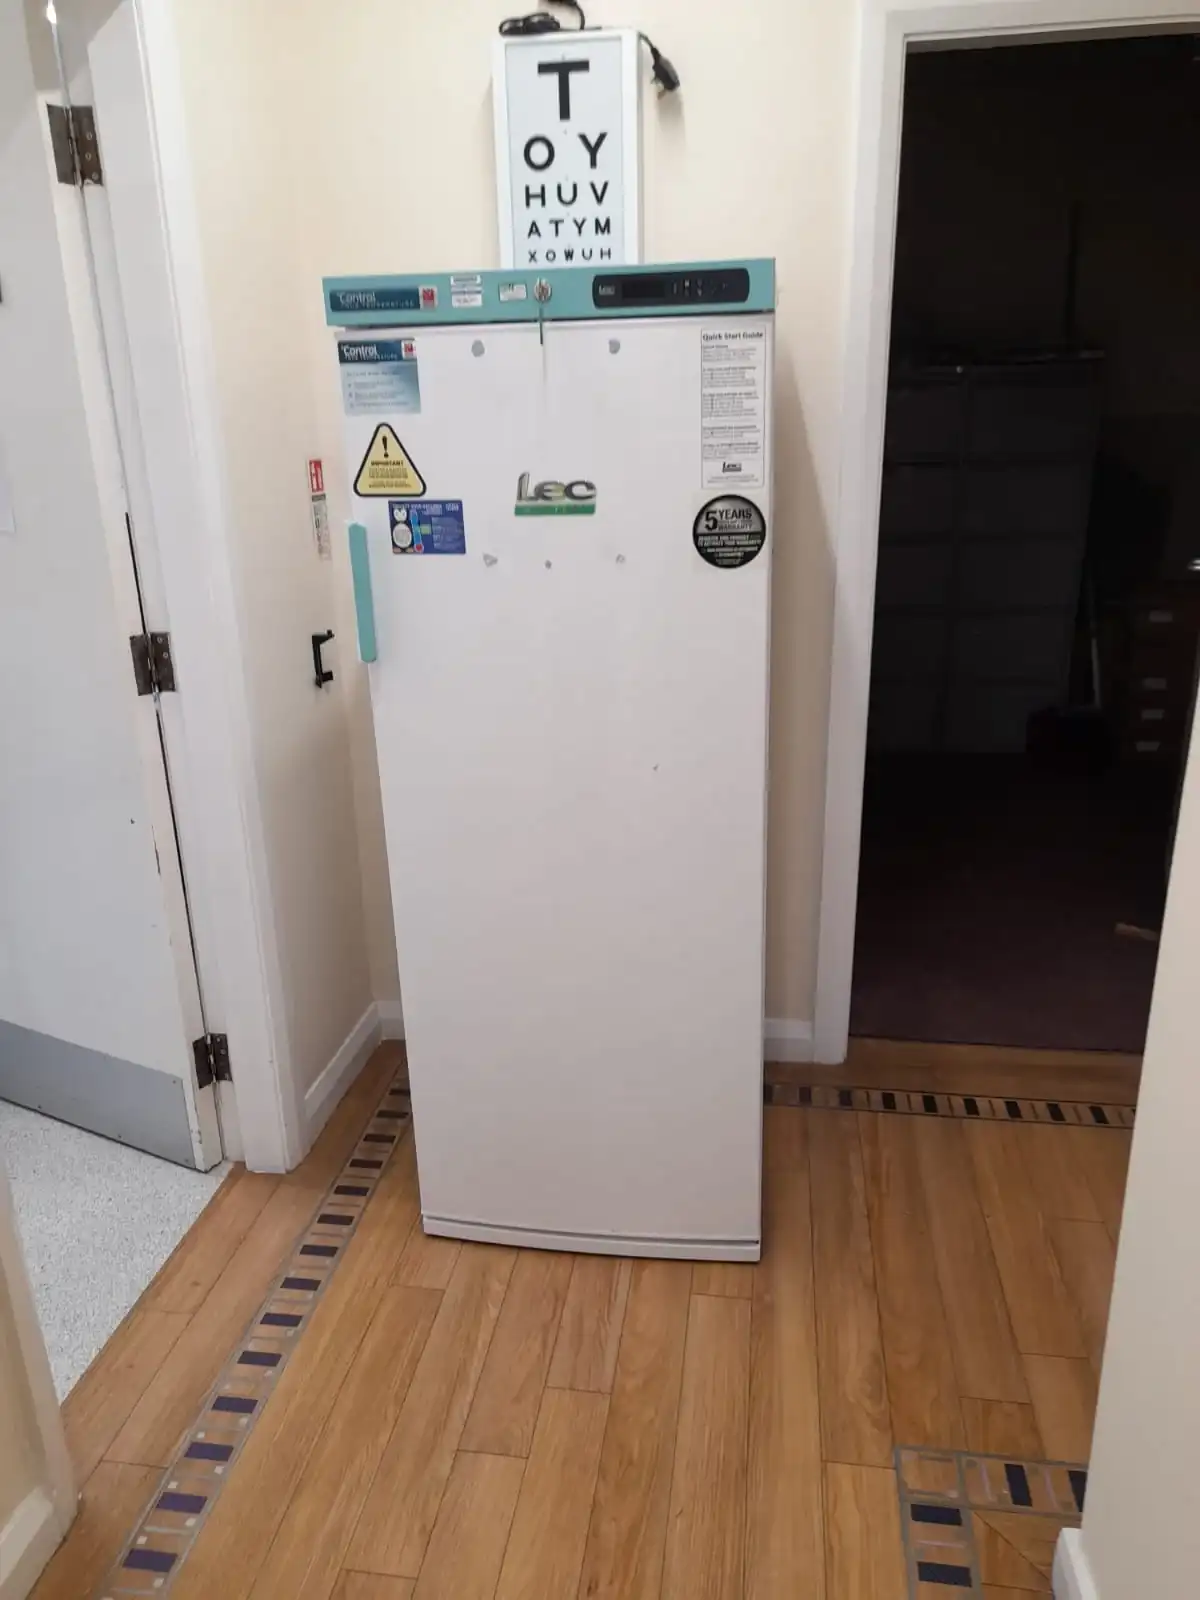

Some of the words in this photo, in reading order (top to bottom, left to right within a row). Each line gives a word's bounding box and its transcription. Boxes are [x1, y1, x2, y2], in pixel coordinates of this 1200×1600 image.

[537, 59, 590, 121] T
[702, 332, 722, 341] Quick
[724, 332, 741, 340] Start
[516, 470, 597, 501] Lec
[704, 510, 718, 531] 5
[718, 507, 753, 520] YEARS
